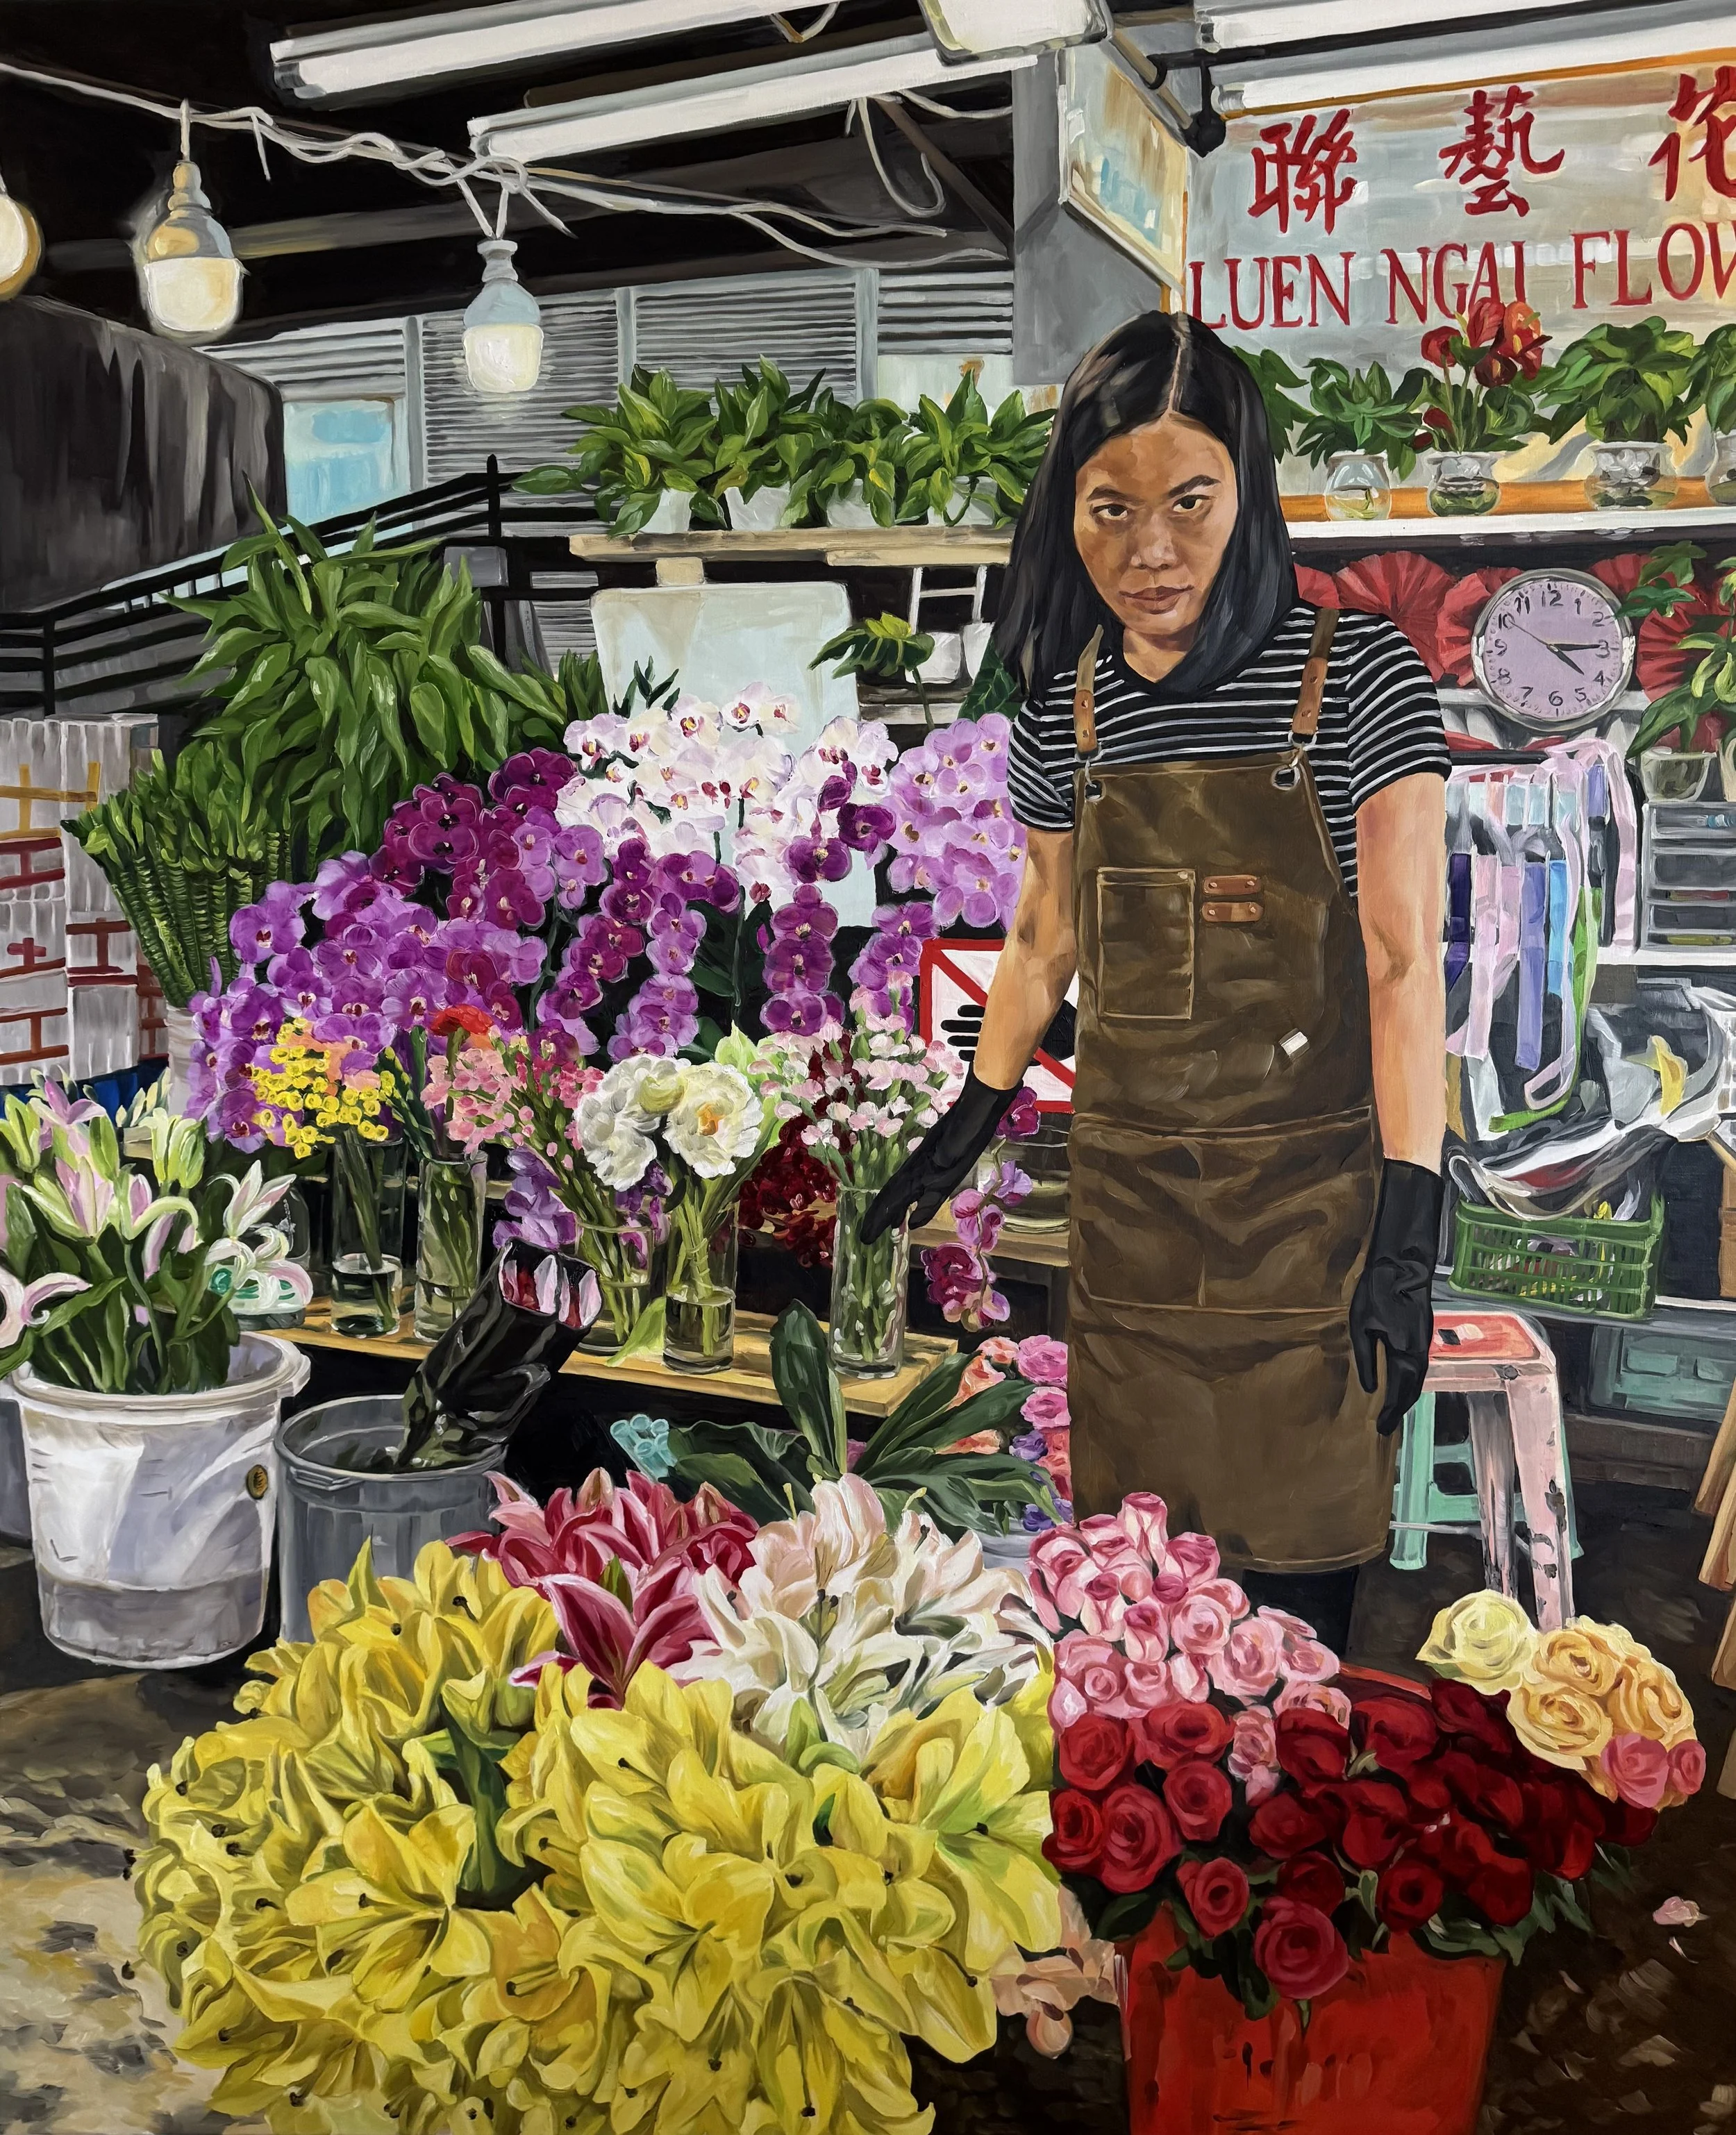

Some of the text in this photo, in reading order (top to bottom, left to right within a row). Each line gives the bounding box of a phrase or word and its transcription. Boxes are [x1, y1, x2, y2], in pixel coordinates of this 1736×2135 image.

[1189, 251, 1356, 330] LUEN
[1380, 240, 1526, 324] NGAI
[1514, 596, 1530, 616] 11
[1542, 589, 1564, 608] 12
[1574, 598, 1582, 614] 1
[1498, 612, 1516, 630] 10
[1592, 611, 1605, 627] 2
[1494, 639, 1508, 656] 9
[1596, 639, 1610, 658] 3
[1497, 668, 1512, 685] 8
[1593, 670, 1604, 687] 4
[1519, 686, 1533, 700] 7
[1549, 690, 1563, 706] 6
[1574, 687, 1587, 702] 5
